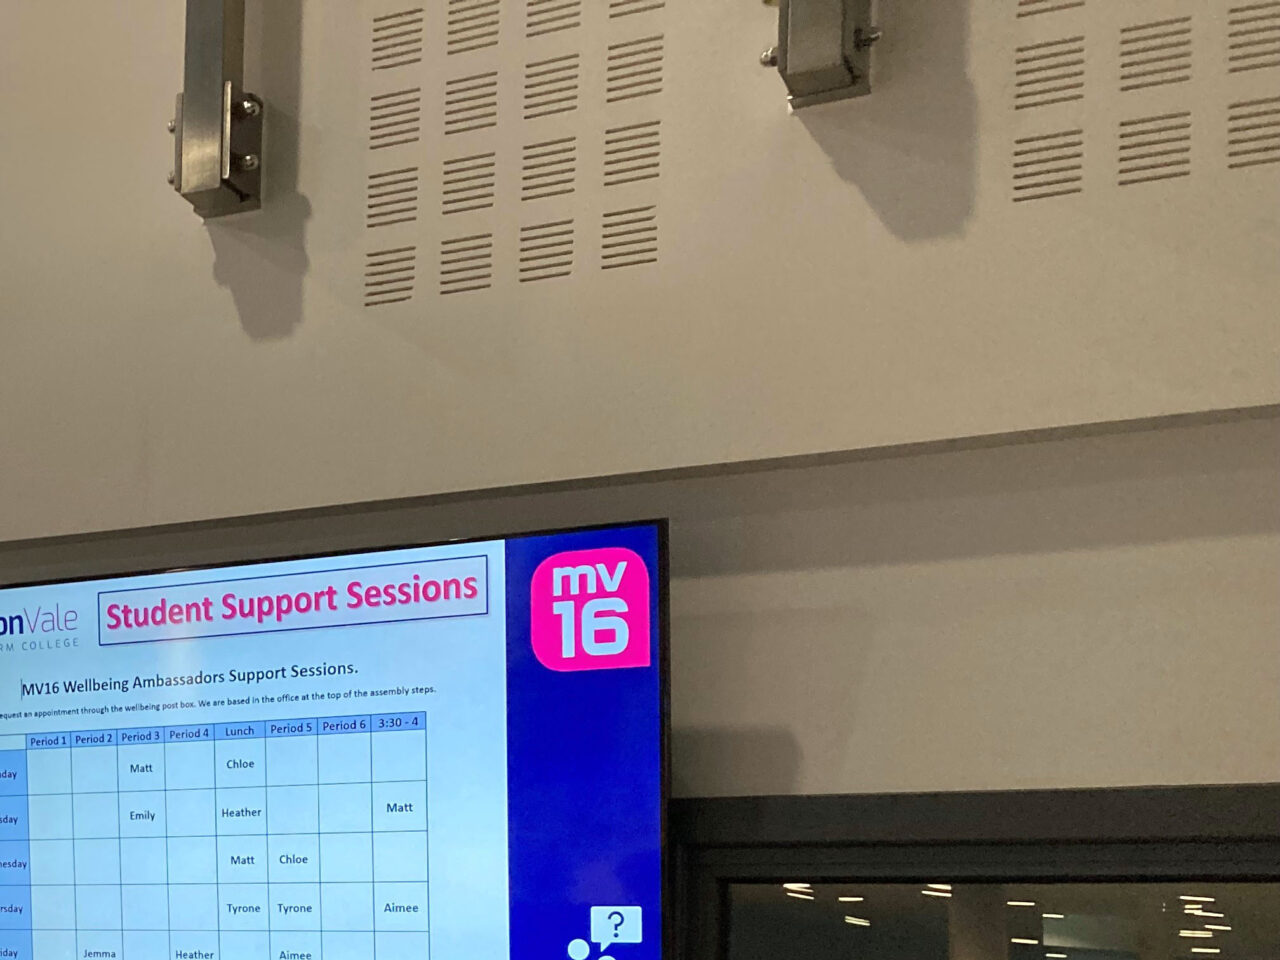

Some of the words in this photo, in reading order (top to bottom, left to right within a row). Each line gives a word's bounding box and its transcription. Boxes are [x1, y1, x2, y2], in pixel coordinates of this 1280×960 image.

[552, 561, 627, 596] mv
[107, 596, 213, 630] Student
[222, 585, 338, 622] Support
[347, 574, 478, 608] Sessions
[552, 598, 629, 658] 16
[21, 638, 79, 651] COLLEGE
[22, 679, 60, 697] MV16
[63, 677, 129, 695] Wellbeing
[133, 670, 225, 690] Ambassadors
[228, 666, 286, 684] Support
[291, 662, 358, 679] Sessions.
[34, 708, 79, 718] appointment
[81, 705, 109, 716] through
[111, 704, 123, 713] the
[124, 703, 160, 713] wellbeing
[162, 702, 178, 711] post
[180, 700, 196, 709] box.
[198, 699, 211, 707] We
[227, 697, 250, 705] based
[252, 696, 260, 704] in
[262, 695, 275, 703] the
[277, 693, 300, 702] office
[311, 691, 325, 700] the
[327, 691, 342, 700] top
[343, 689, 353, 699] of
[354, 689, 368, 698] the
[370, 686, 409, 697] assembly
[411, 685, 436, 695] steps.
[323, 721, 357, 731] Period
[360, 720, 366, 729] 6
[379, 718, 402, 728] 3:30
[412, 717, 419, 727] 4
[170, 729, 199, 740] Period
[202, 728, 209, 738] 4
[225, 726, 255, 736] Lunch
[271, 723, 303, 734] Period
[306, 723, 313, 732] 5
[30, 736, 58, 746] Period
[61, 736, 67, 745] 1
[76, 733, 104, 744] Period
[107, 734, 113, 742] 2
[121, 731, 151, 742] Period
[154, 731, 160, 740] 3
[130, 763, 153, 773] Matt
[226, 759, 255, 769] Chloe
[221, 807, 261, 818] Heather
[386, 803, 413, 813] Matt
[129, 811, 156, 822] Emily
[230, 855, 255, 865] Matt
[279, 854, 308, 864] Chloe
[226, 904, 261, 915] Tyrone
[277, 904, 313, 915] Tyrone
[384, 903, 419, 913] Aimee
[83, 949, 116, 959] Jemma
[175, 950, 214, 960] Heather
[279, 950, 312, 960] Aimee
